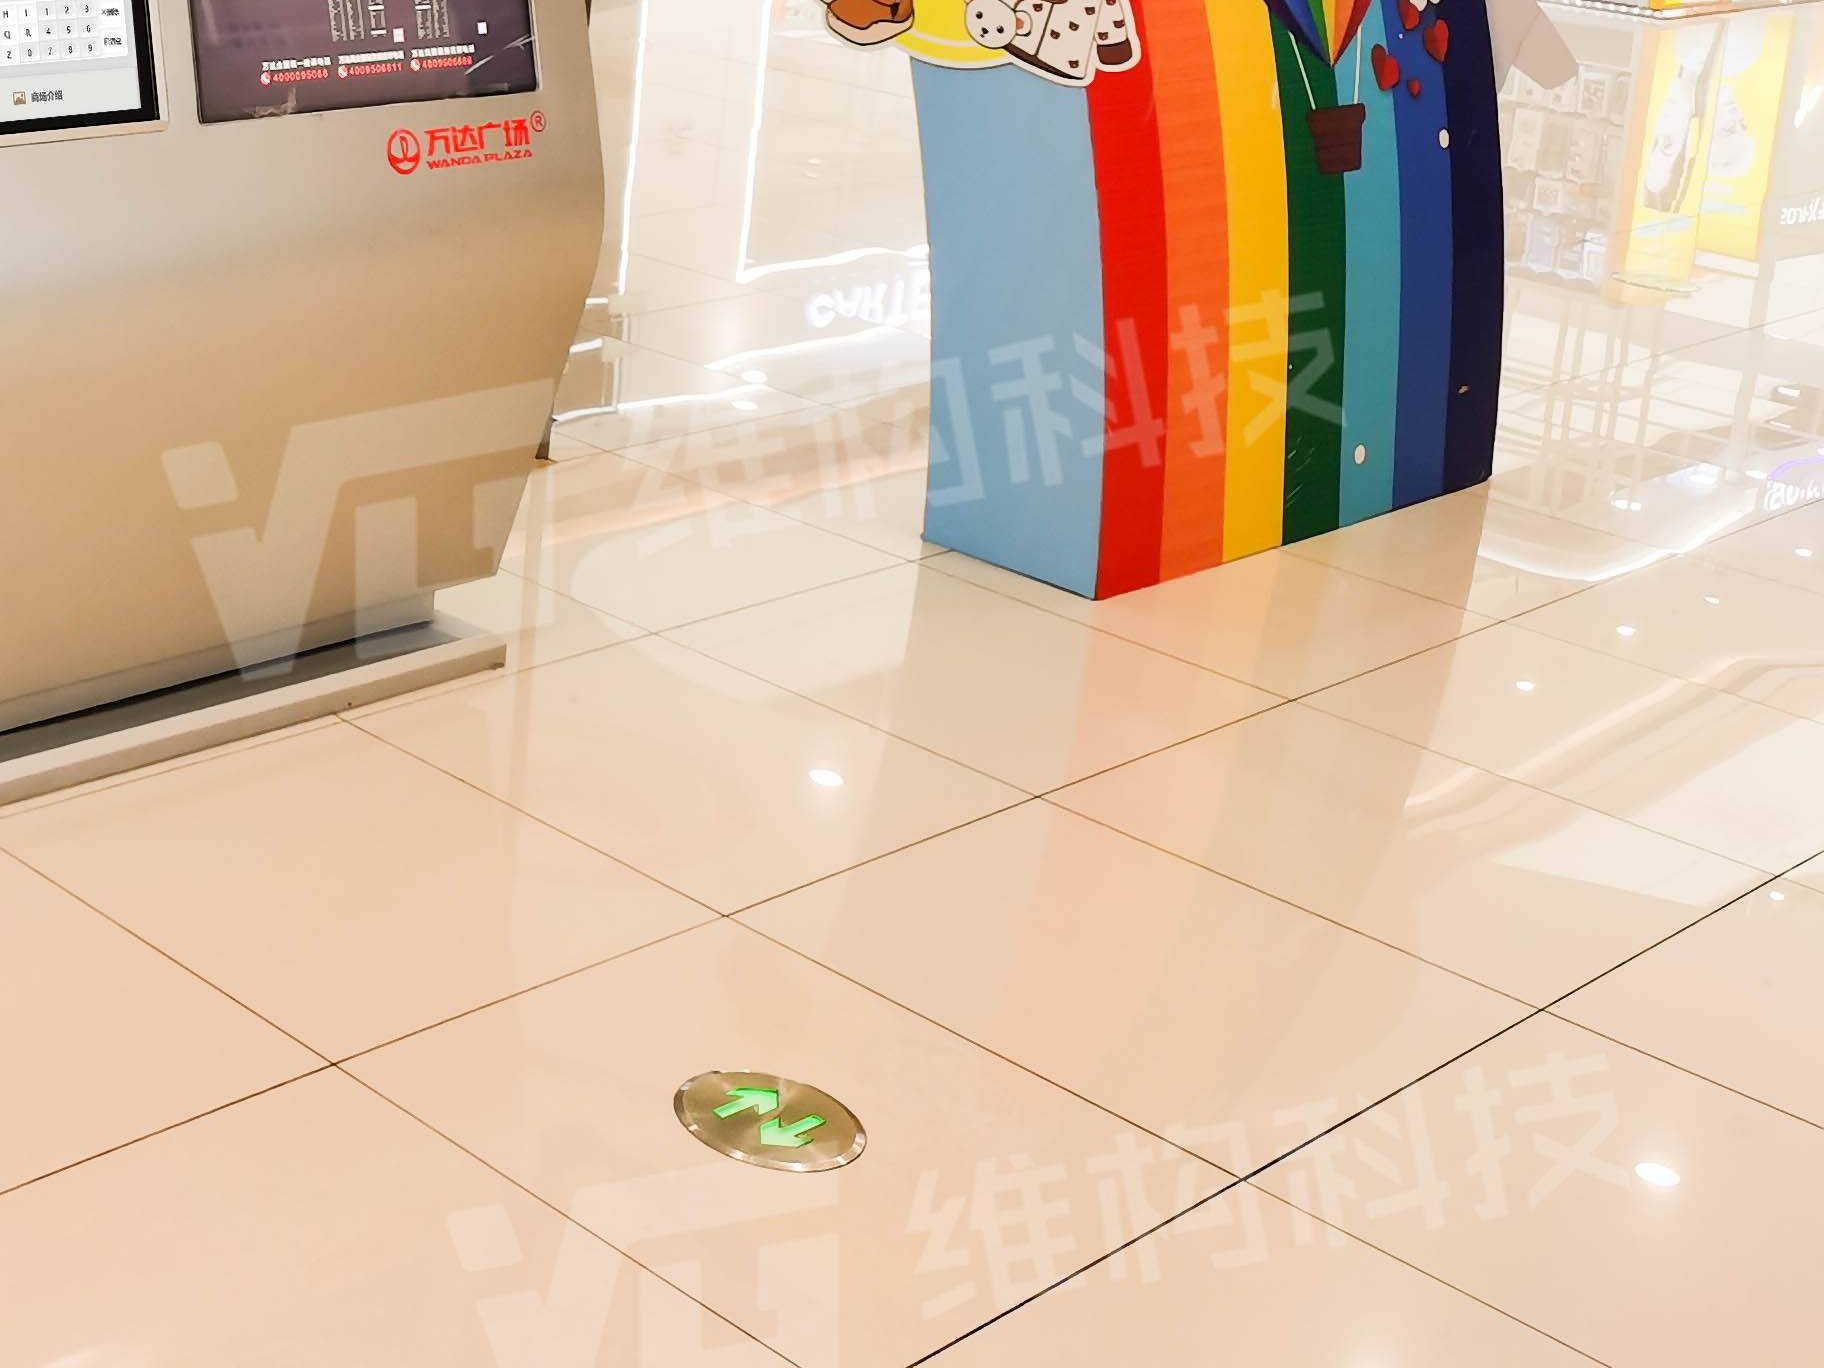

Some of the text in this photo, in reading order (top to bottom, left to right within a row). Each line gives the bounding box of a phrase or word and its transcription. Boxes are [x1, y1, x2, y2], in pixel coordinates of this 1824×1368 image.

[31, 89, 63, 103] 商场介绍
[425, 119, 530, 155] 万达广场
[427, 149, 532, 169] WANDA PLAZA
